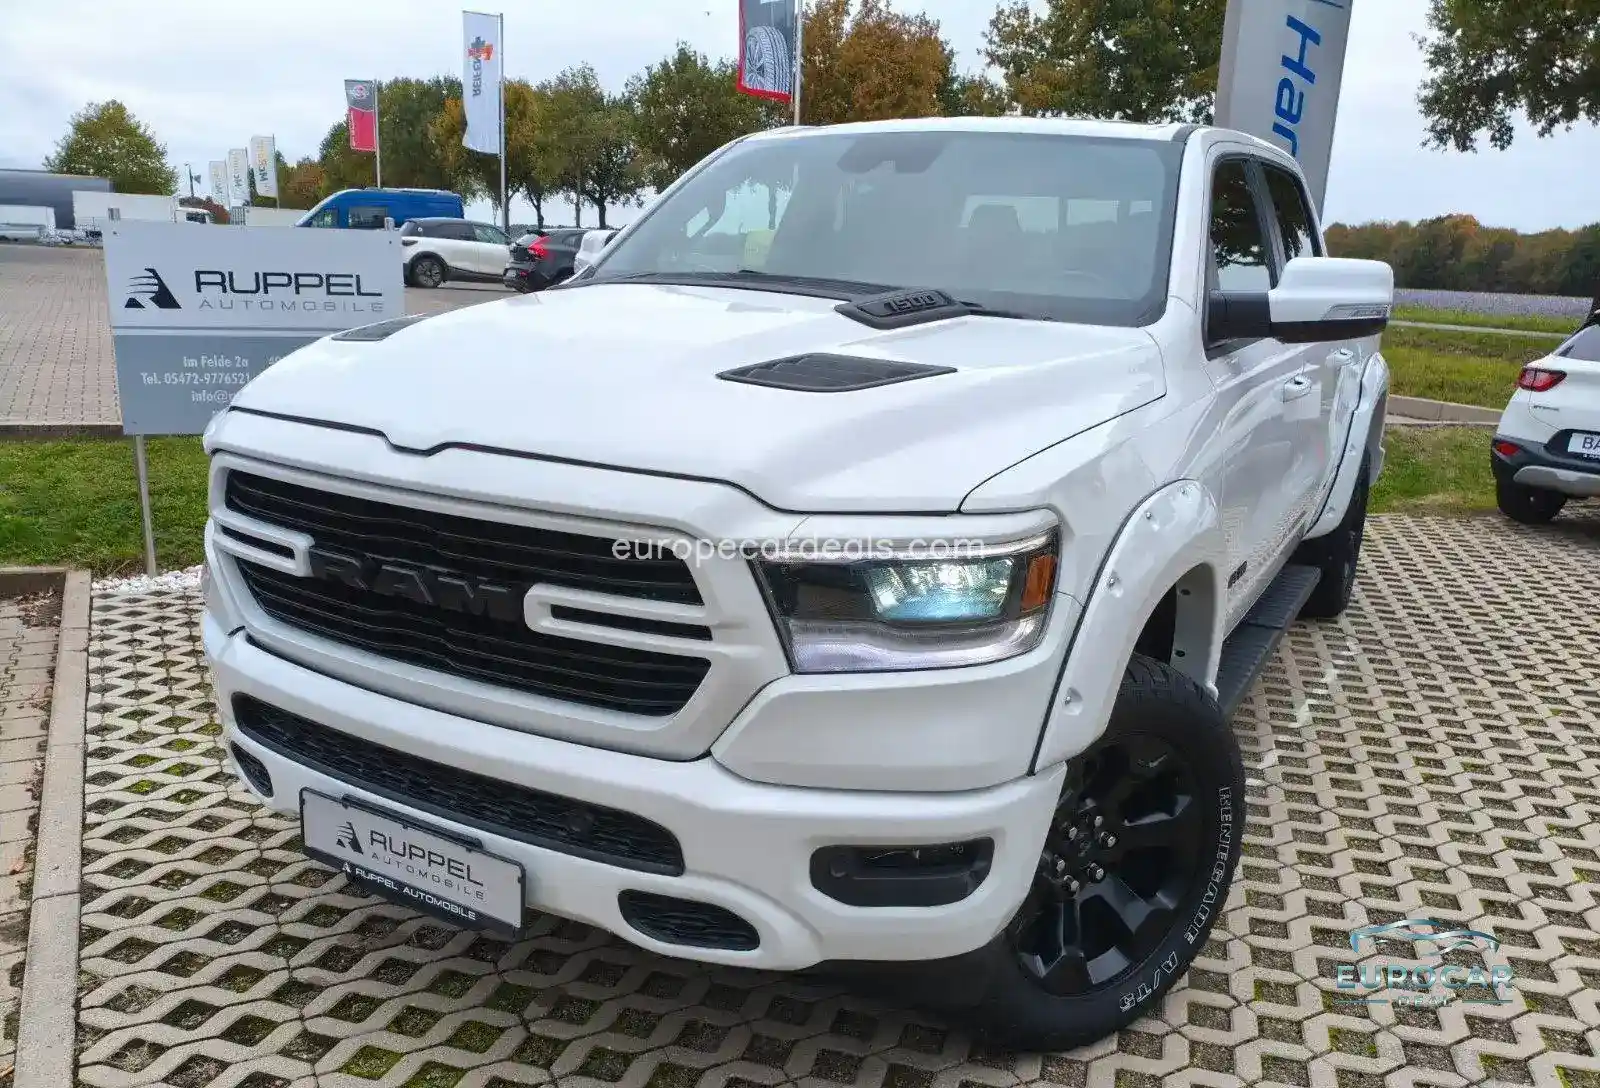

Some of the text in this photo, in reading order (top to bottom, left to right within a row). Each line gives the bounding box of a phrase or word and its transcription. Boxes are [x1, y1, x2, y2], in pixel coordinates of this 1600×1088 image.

[194, 270, 383, 297] RUPPEL
[199, 299, 384, 313] AUTOMOBILE
[140, 372, 162, 385] Tel.
[183, 356, 198, 367] Im
[201, 355, 233, 367] Felde
[235, 356, 249, 367] 2a
[311, 547, 526, 622] RAM
[370, 829, 484, 887] RUPPEL
[371, 852, 485, 900] AUTOMOBILE
[355, 867, 476, 921] RUPPEL AUTOMOBILE
